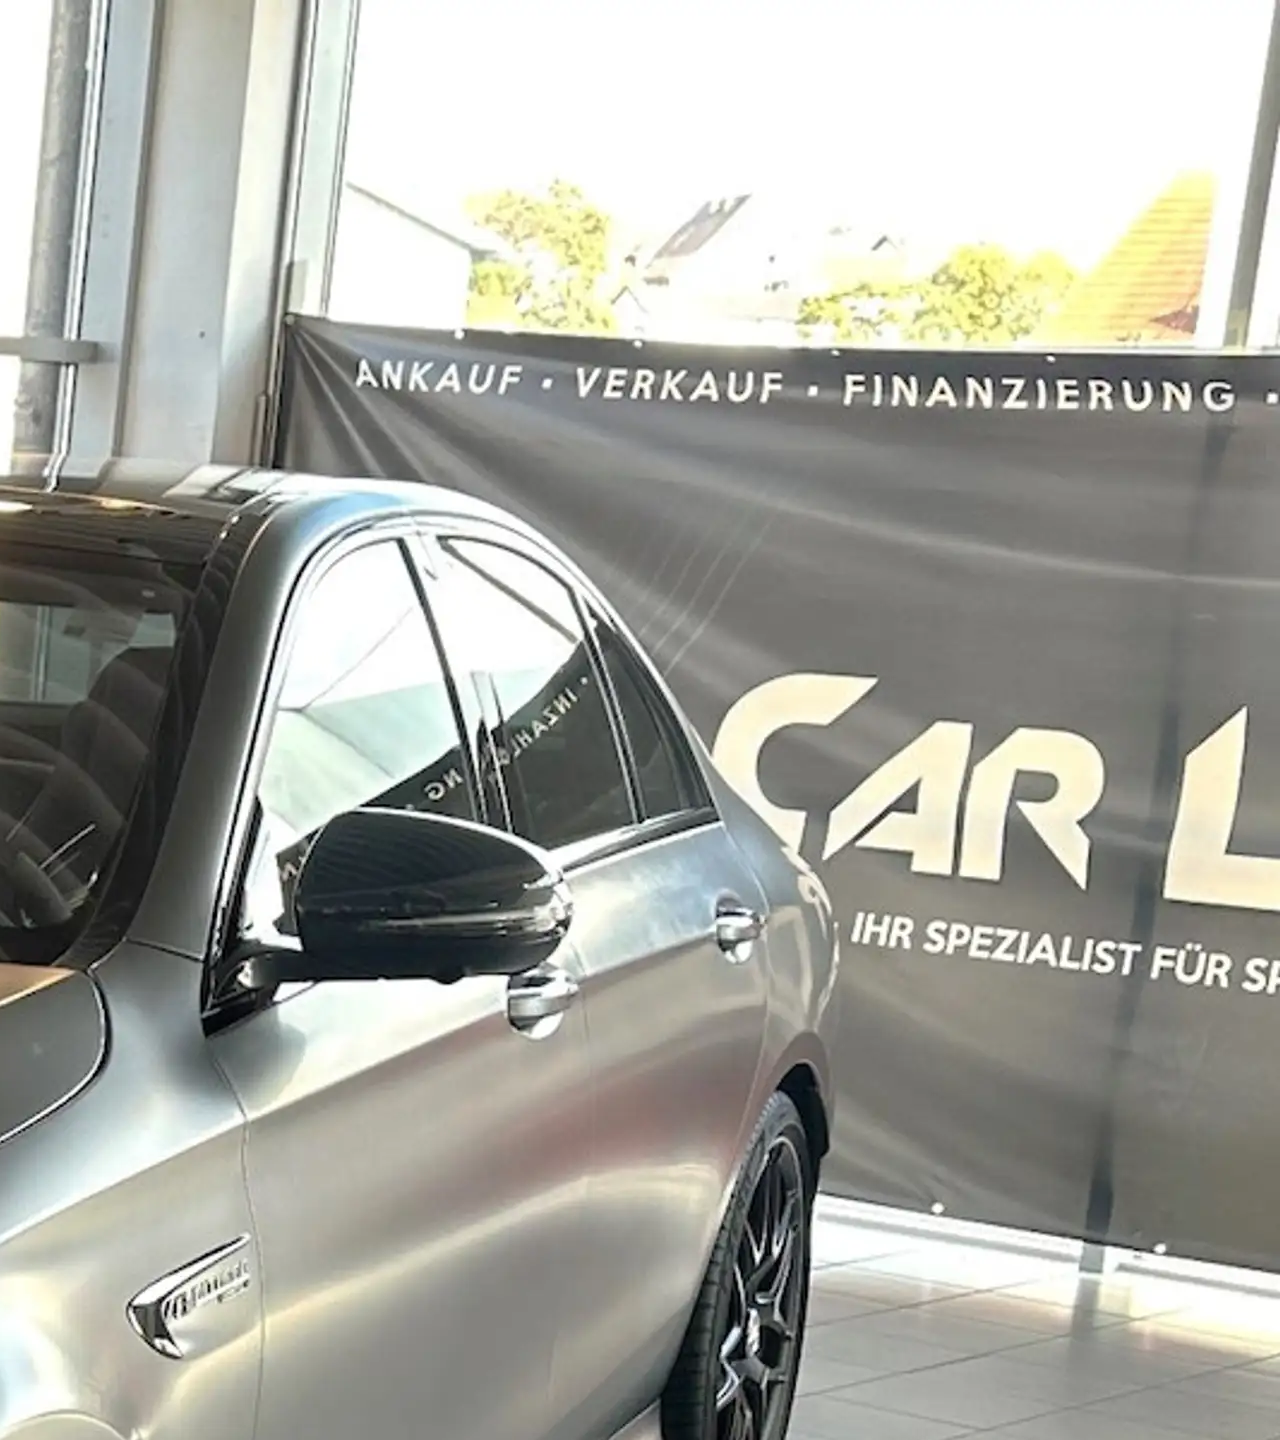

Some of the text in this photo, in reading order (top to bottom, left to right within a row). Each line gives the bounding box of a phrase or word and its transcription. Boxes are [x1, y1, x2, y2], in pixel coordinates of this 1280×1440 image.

[356, 358, 1235, 412] ANKAUF VERKAUF FINANZIERUNG
[711, 672, 1105, 890] CAR
[851, 912, 913, 949] IHR
[923, 921, 1142, 976] SPEZIALIST
[1150, 942, 1232, 988] FÜR
